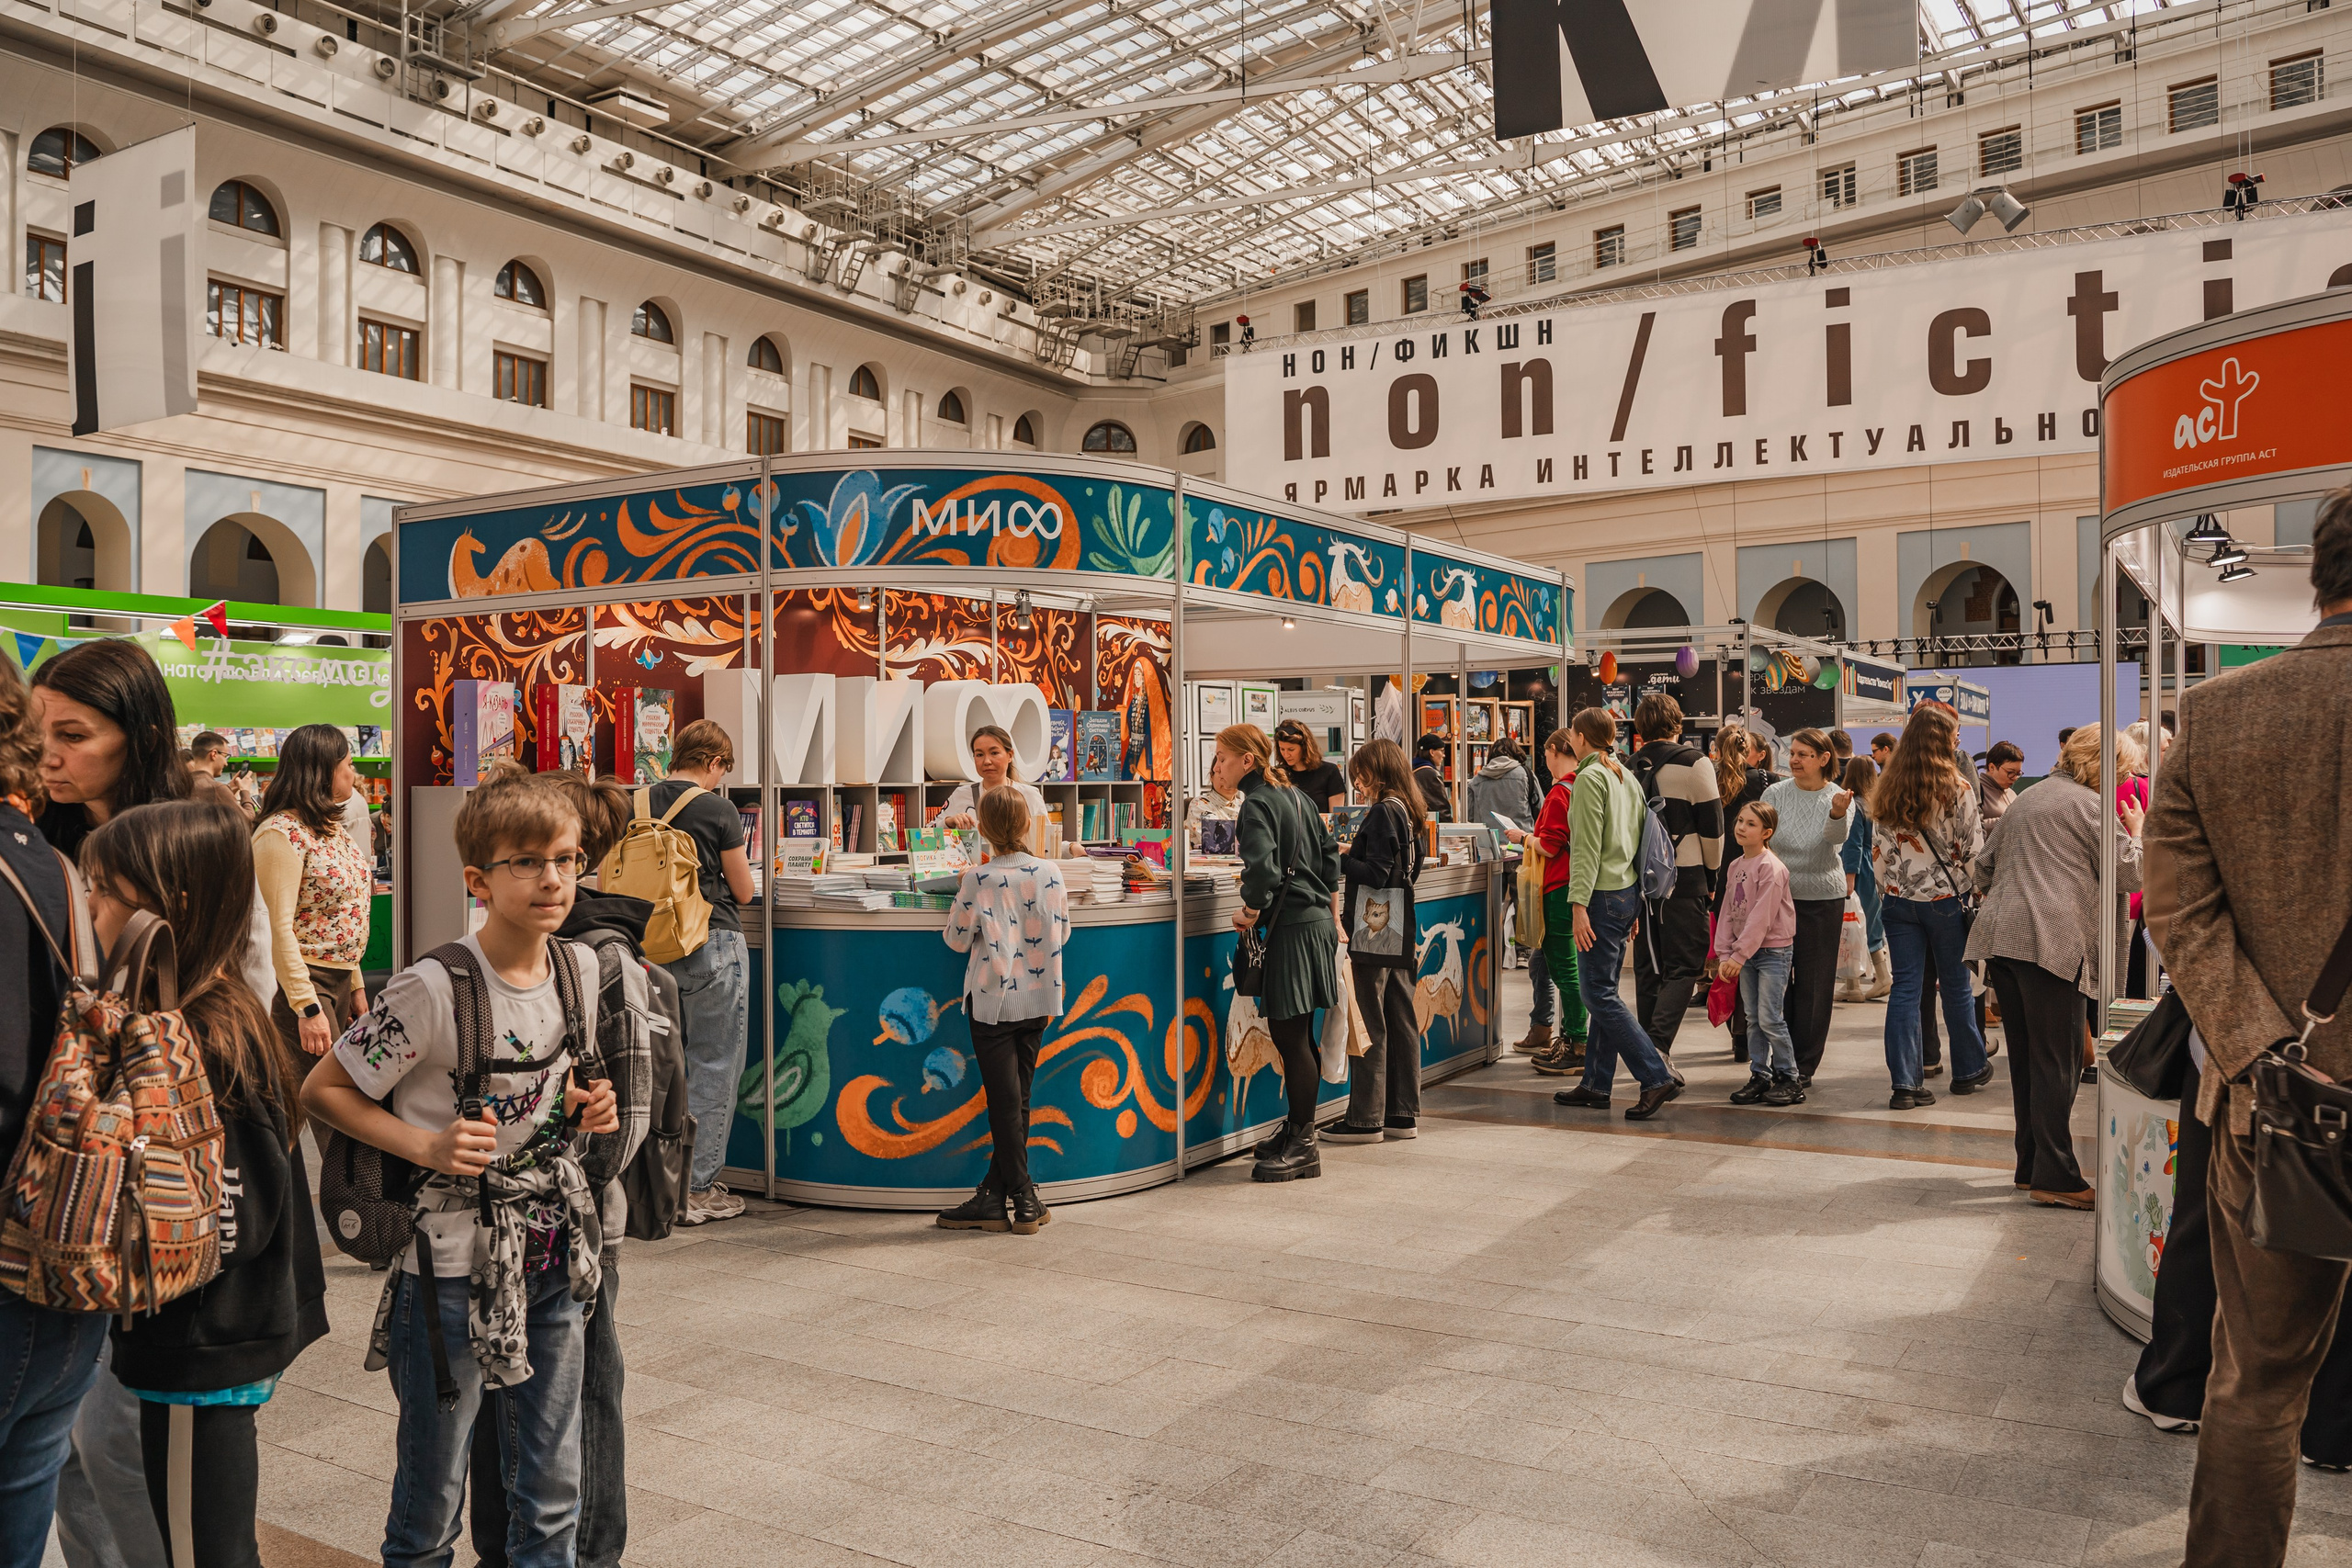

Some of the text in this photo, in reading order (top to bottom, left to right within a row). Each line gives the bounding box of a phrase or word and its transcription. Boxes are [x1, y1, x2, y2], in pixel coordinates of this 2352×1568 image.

[1283, 318, 1554, 378] НОН/ФИКШН
[2163, 447, 2278, 479] ИЗДАТЕЛЬСКАЯ ГРУППА АСТ
[1284, 463, 1495, 502] ЯРМАРКА
[482, 694, 508, 711] Я-КАЗАНЬ
